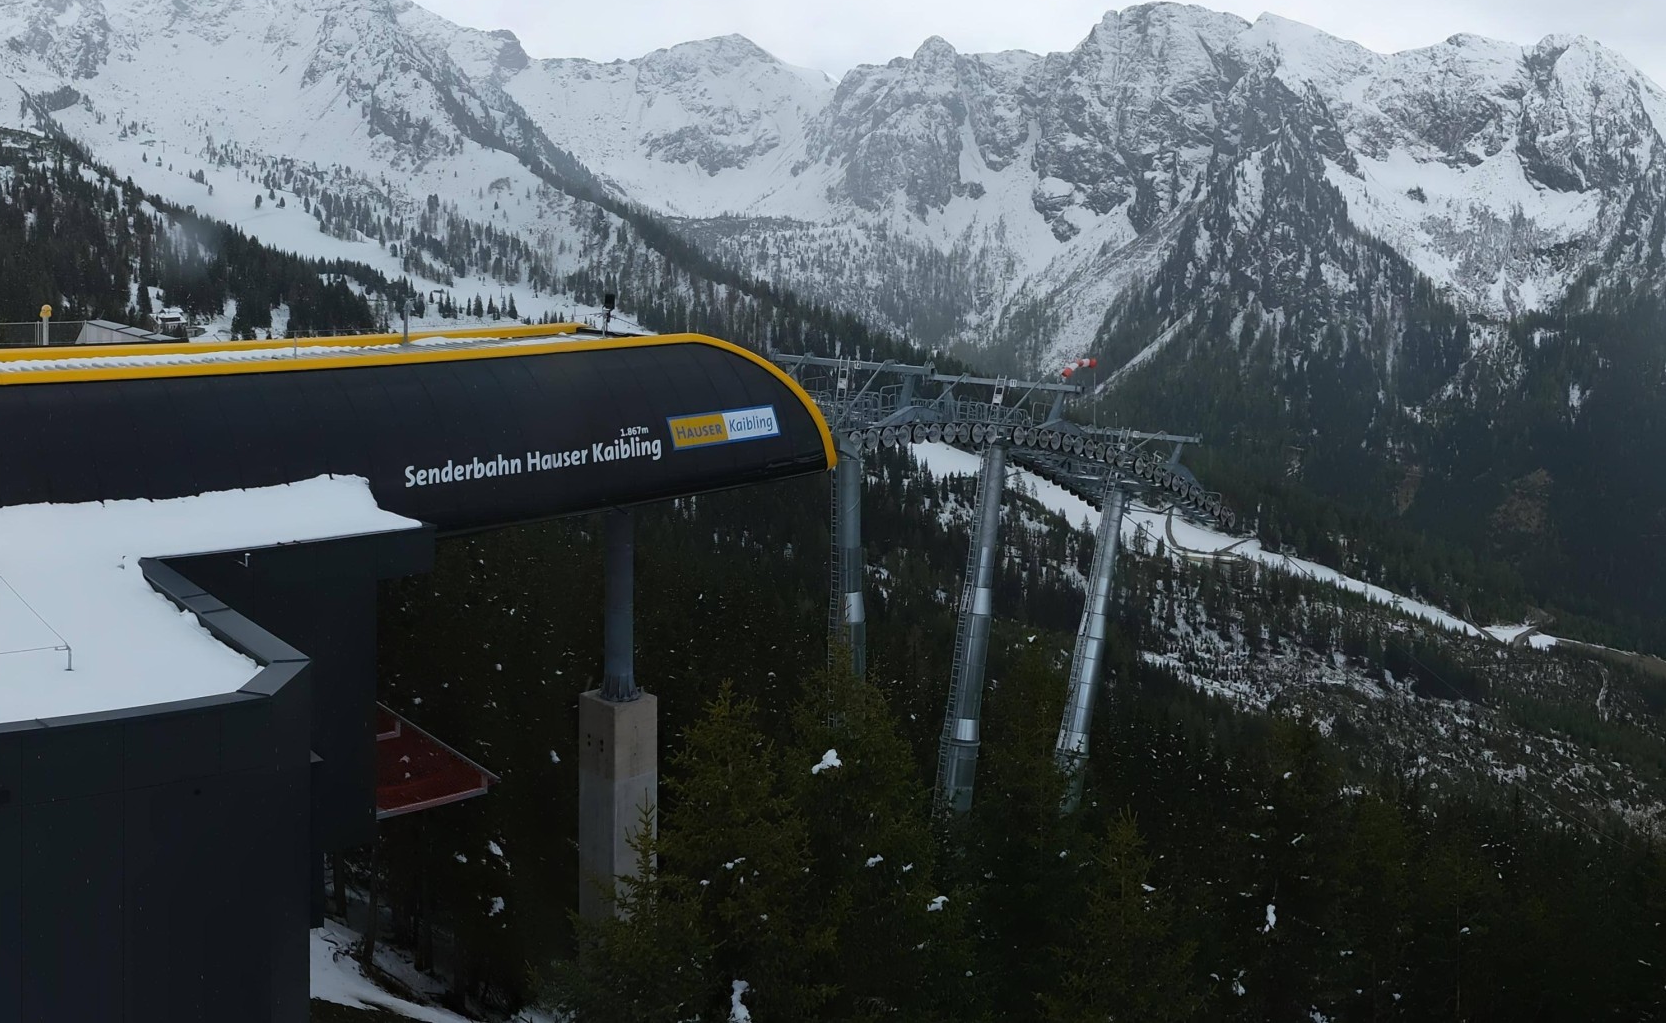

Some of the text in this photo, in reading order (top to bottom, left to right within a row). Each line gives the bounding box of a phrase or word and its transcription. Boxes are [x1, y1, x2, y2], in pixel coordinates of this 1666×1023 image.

[620, 426, 649, 437] 1.867m
[729, 412, 774, 434] Kaibling
[404, 436, 662, 488] Senderbahn Hauser Kaibling
